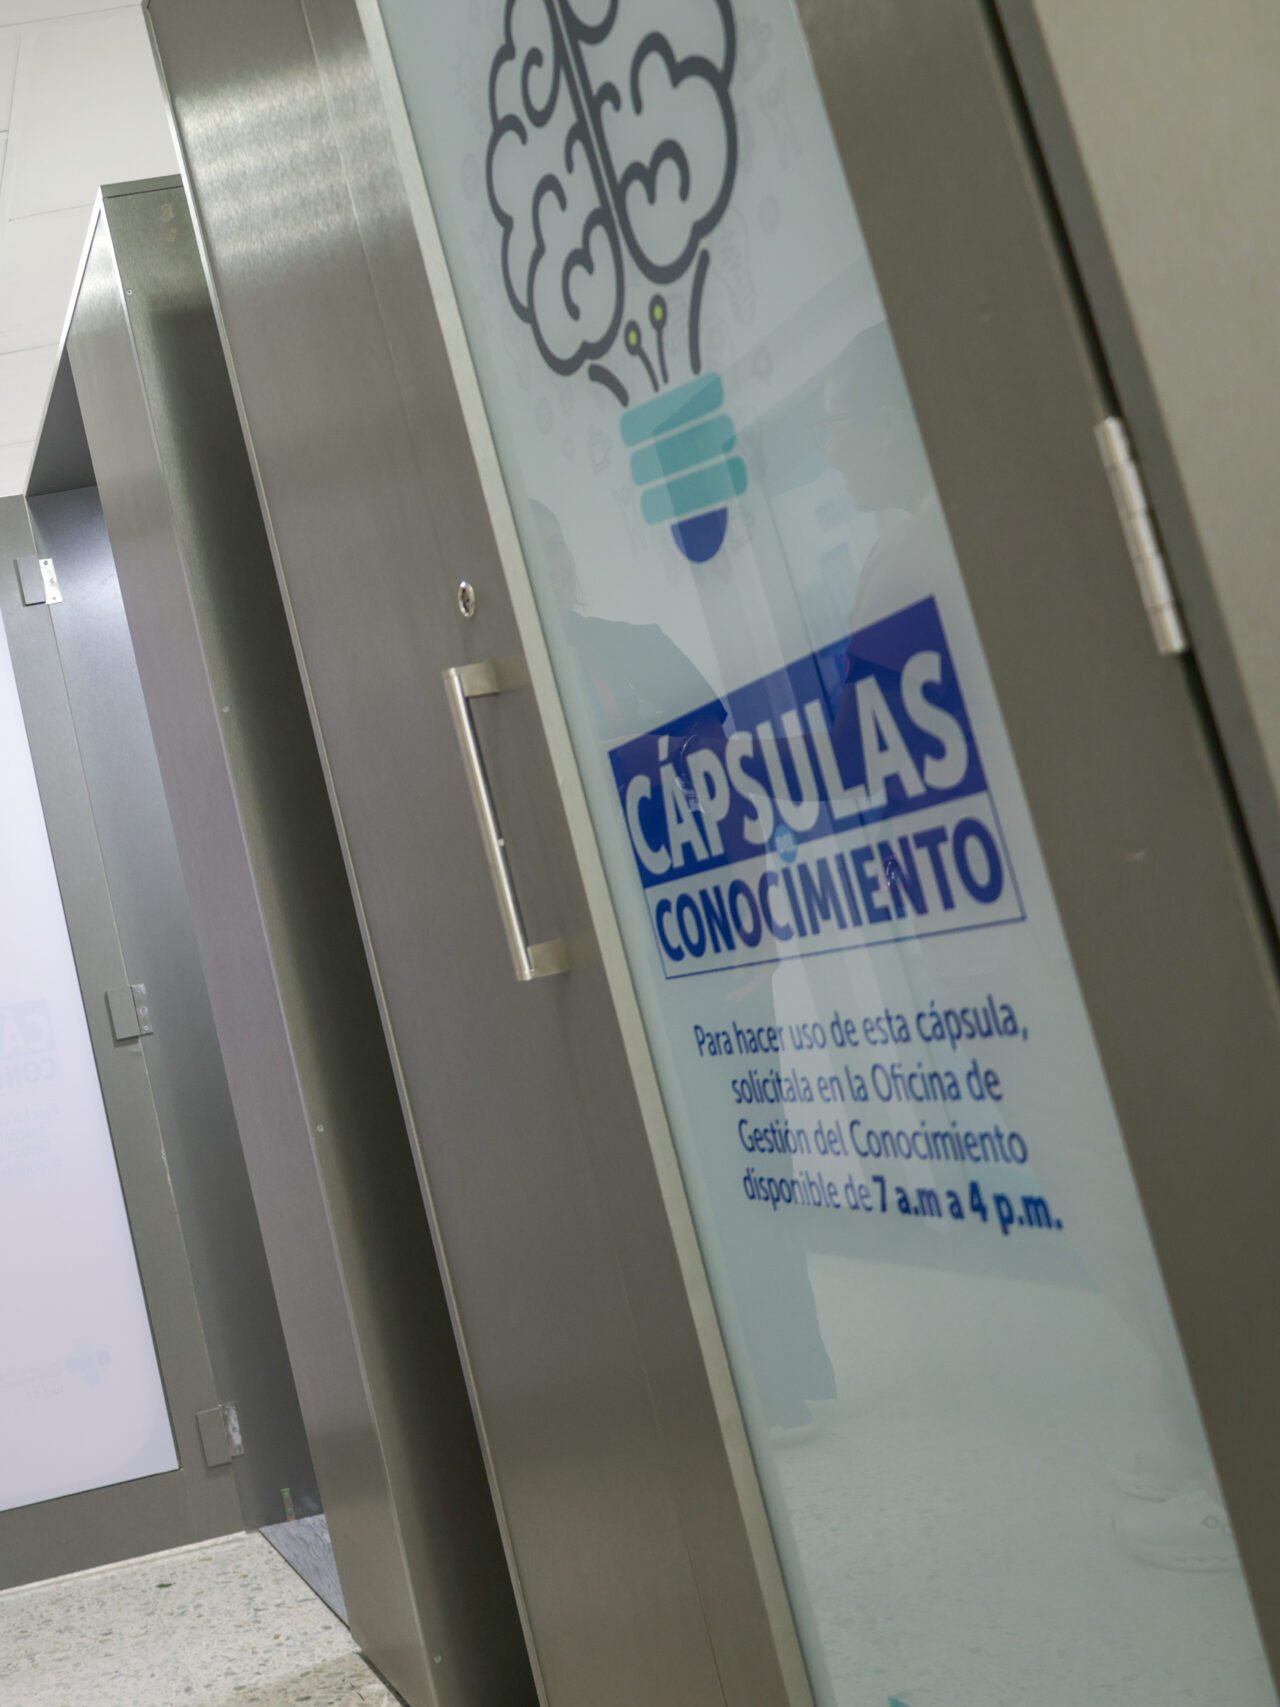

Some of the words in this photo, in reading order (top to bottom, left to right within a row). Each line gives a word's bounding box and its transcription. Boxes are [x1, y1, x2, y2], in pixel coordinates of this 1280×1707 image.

[626, 650, 969, 875] CÁPSULAS
[656, 817, 1004, 962] CONOCIMIENTO
[693, 1025, 734, 1057] Para
[732, 1021, 786, 1055] hacer
[788, 1022, 827, 1050] uso
[830, 1010, 859, 1048] de
[862, 1008, 911, 1045] esta
[916, 993, 1028, 1052] cápsula,
[731, 1067, 814, 1104] solicítala
[817, 1075, 845, 1103] en
[844, 1065, 869, 1102] la
[871, 1062, 962, 1102] Oficina
[966, 1058, 1003, 1101] de
[738, 1118, 811, 1154] Gestión
[813, 1119, 849, 1157] del
[849, 1119, 1028, 1164] Conocimiento
[742, 1167, 841, 1211] disponible
[843, 1173, 873, 1212] de
[871, 1174, 887, 1213] 7
[895, 1186, 943, 1218] a.m
[945, 1189, 965, 1220] a
[969, 1181, 988, 1223] 4
[993, 1193, 1065, 1236] p.m.
